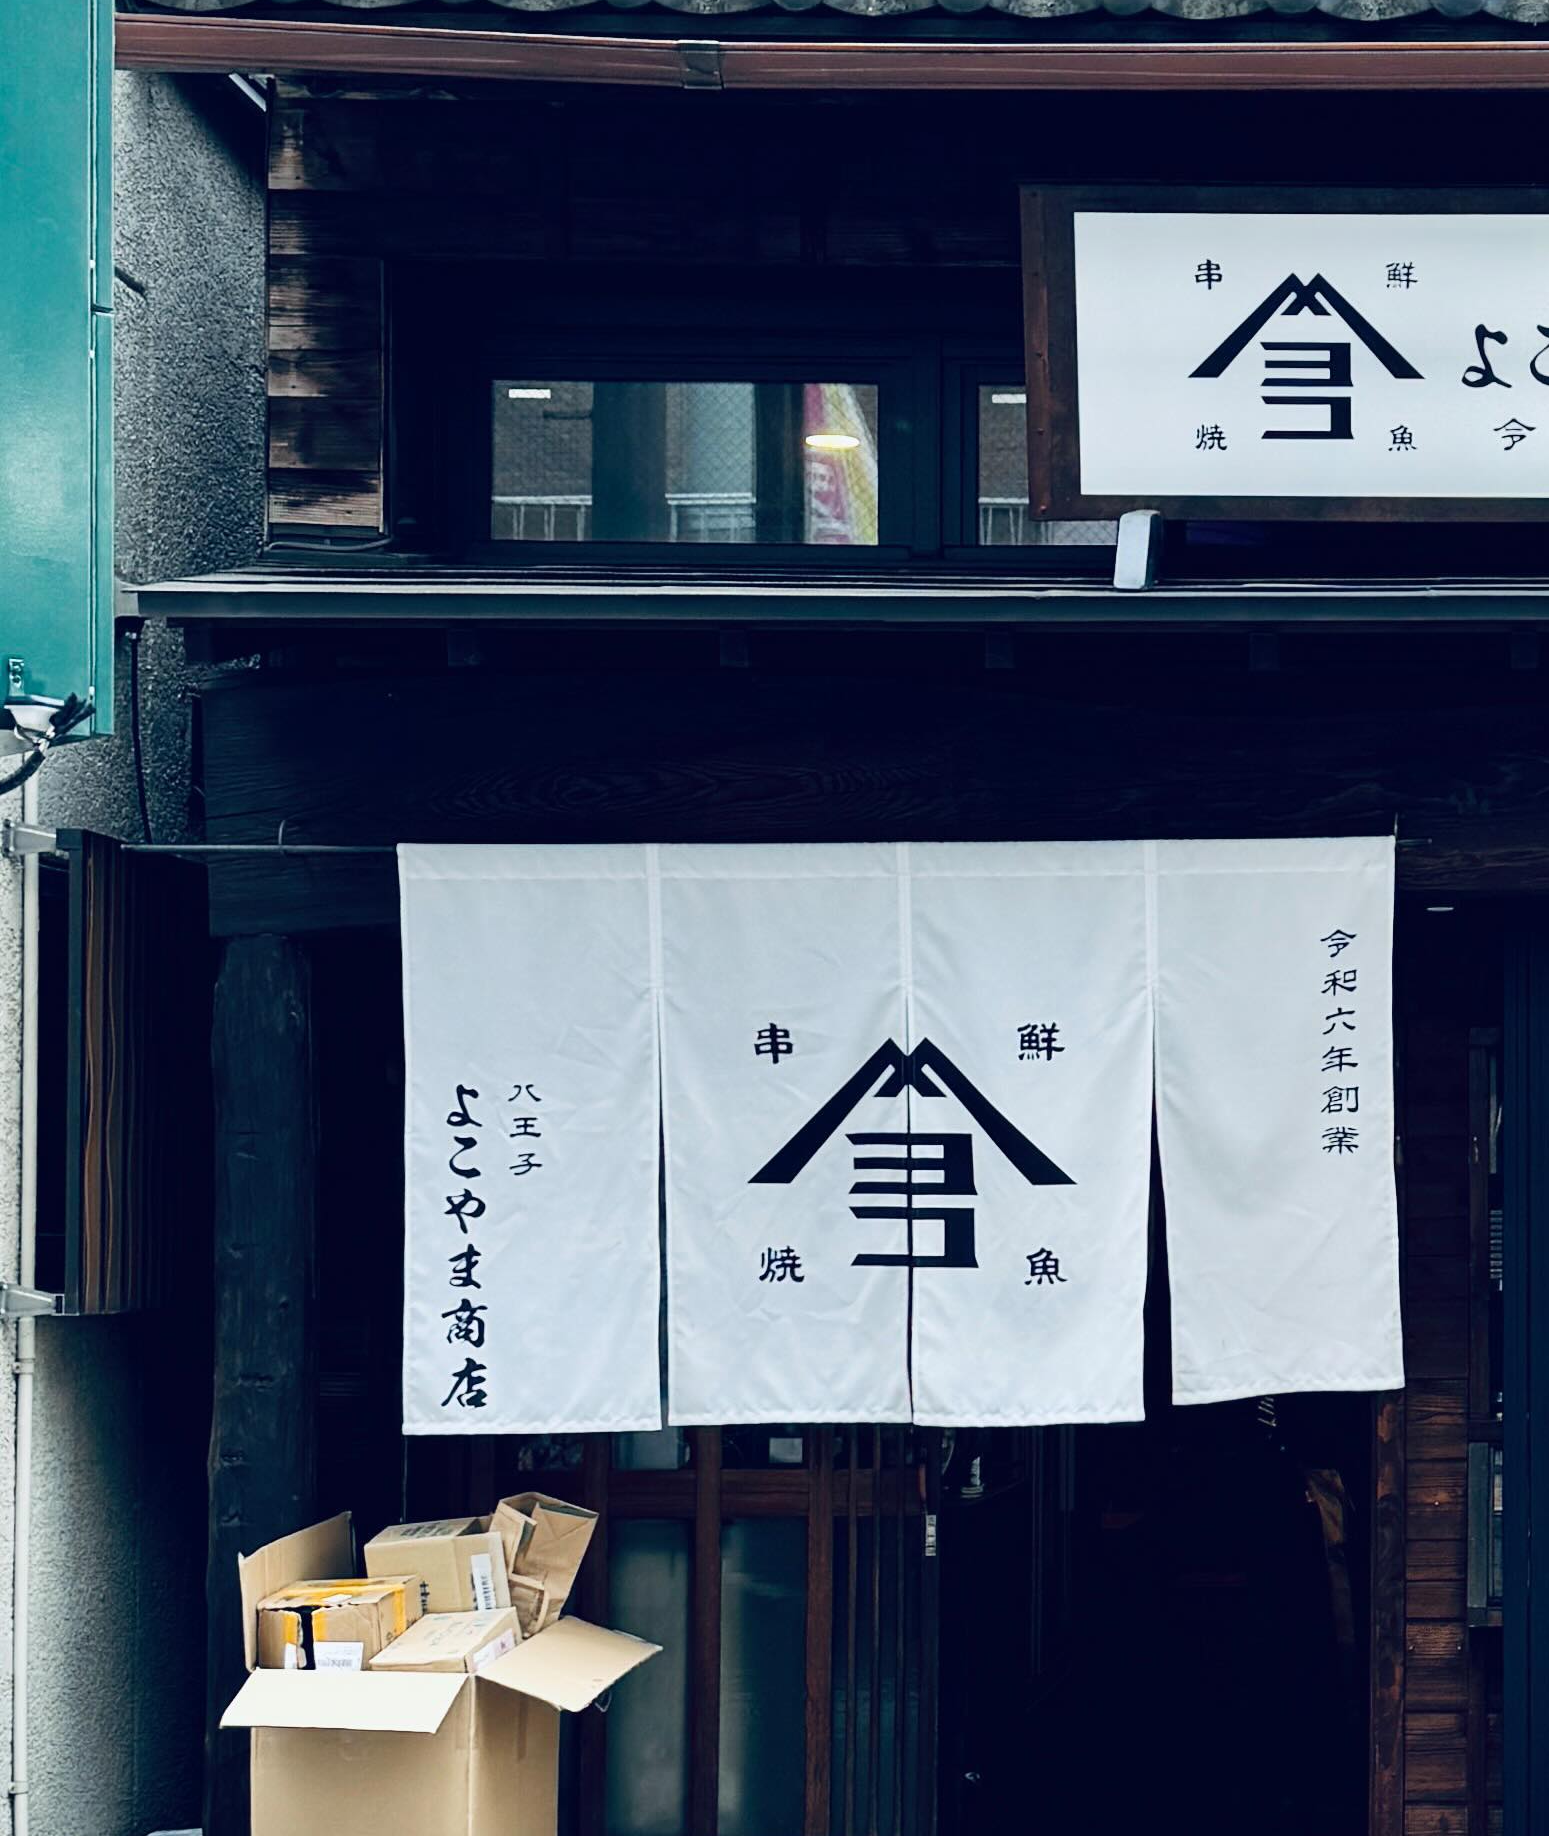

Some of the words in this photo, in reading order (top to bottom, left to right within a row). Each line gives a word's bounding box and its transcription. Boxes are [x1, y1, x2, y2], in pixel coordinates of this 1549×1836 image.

[1194, 258, 1223, 291] 串
[1385, 261, 1418, 289] 鮮
[1195, 424, 1228, 451] 焼
[1388, 424, 1417, 452] 魚
[753, 1022, 794, 1065] 串
[1016, 1022, 1066, 1062] 鮮
[1319, 929, 1360, 1155] 令和六年創業
[507, 1083, 543, 1176] 八王子
[440, 1084, 488, 1409] よこやま商店
[758, 1245, 805, 1283] 焼
[1024, 1247, 1068, 1286] 魚
